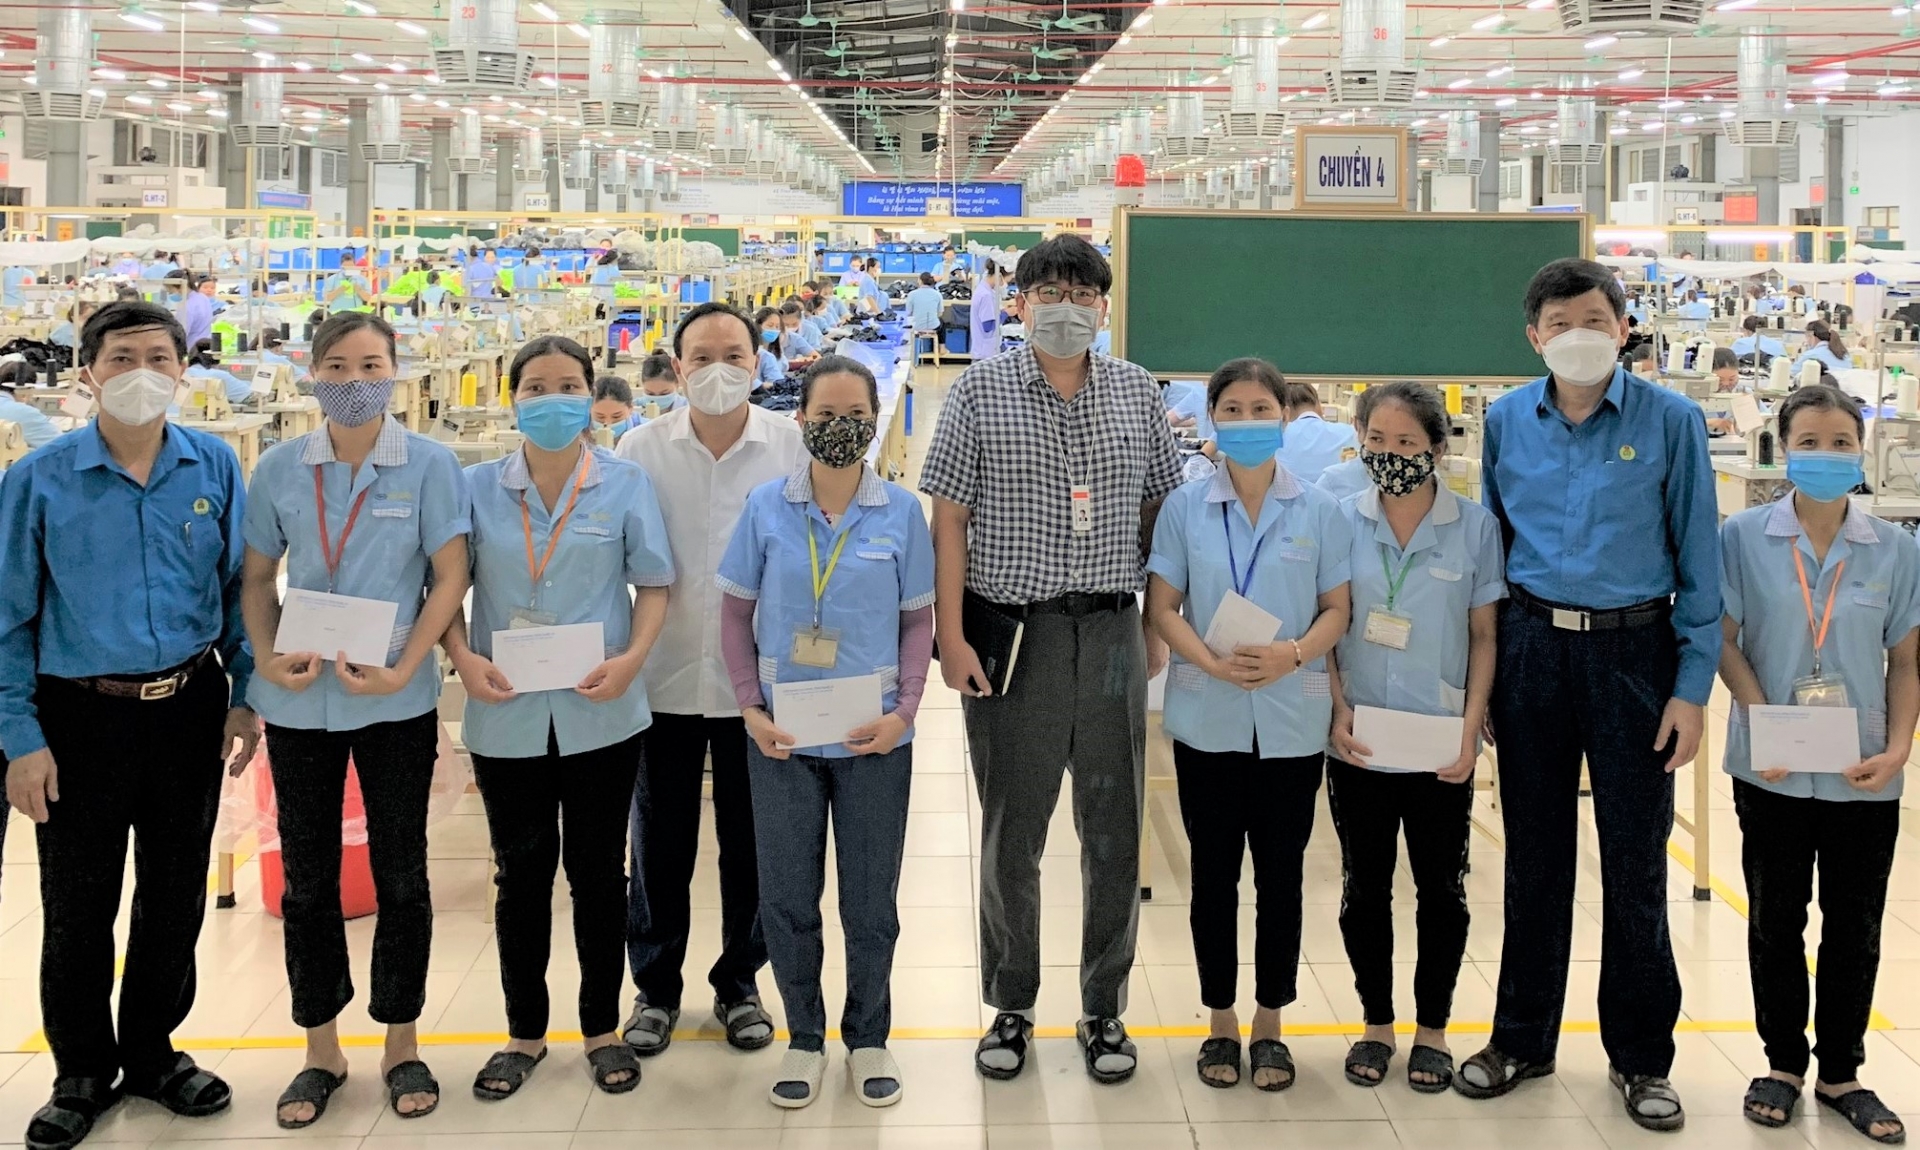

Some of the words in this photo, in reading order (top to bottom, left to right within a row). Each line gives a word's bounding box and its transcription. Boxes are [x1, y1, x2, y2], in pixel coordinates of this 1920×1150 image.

[461, 6, 476, 19] 23
[1373, 27, 1387, 40] 36
[601, 63, 613, 73] 22
[1256, 82, 1267, 92] 35
[1319, 145, 1371, 188] CHUYỀN
[1376, 156, 1385, 188] 4
[526, 198, 547, 207] G.HT-3
